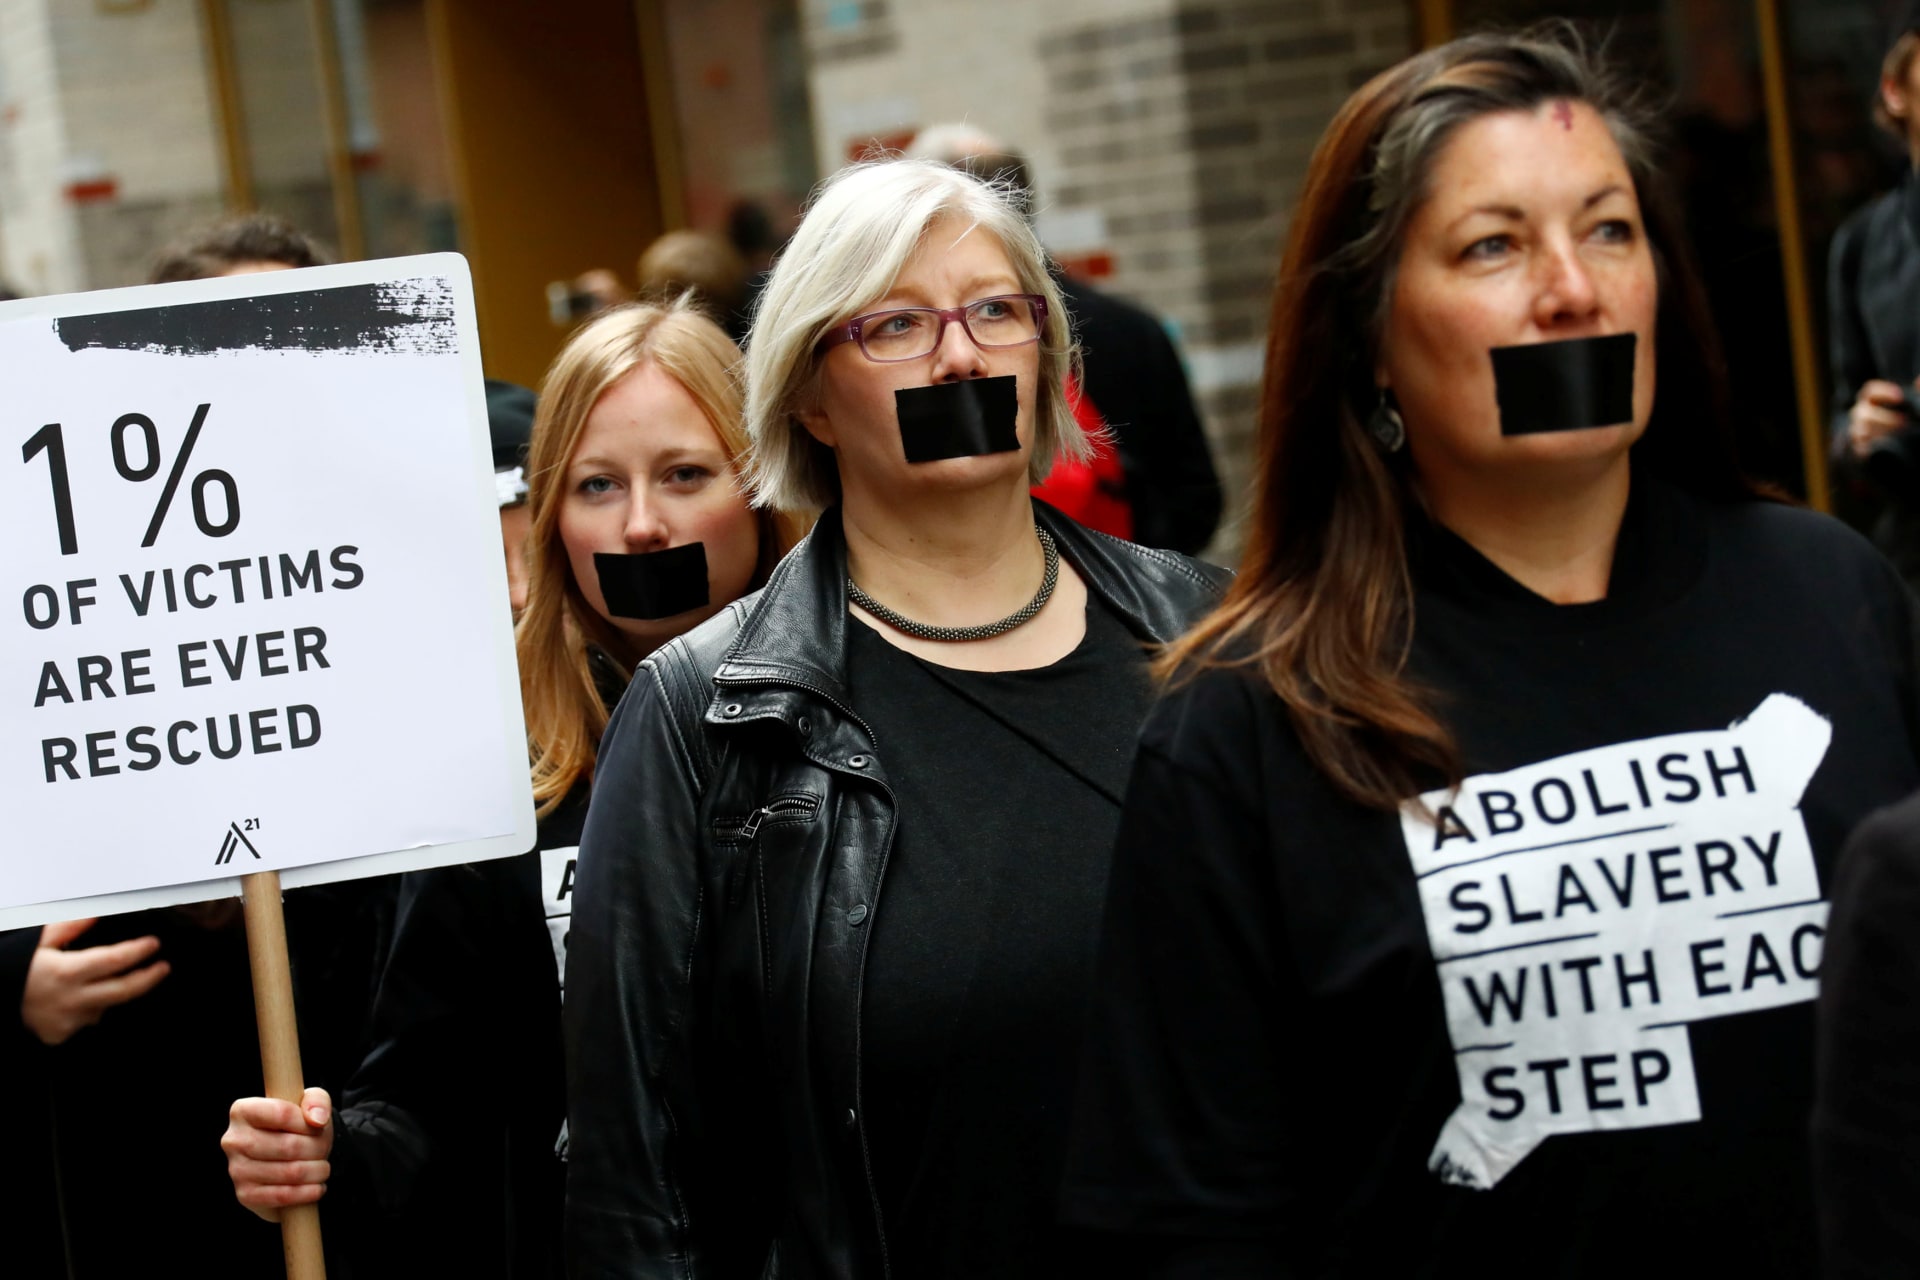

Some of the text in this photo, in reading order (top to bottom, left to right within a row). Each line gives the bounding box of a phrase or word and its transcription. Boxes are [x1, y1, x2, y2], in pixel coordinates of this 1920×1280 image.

[21, 403, 242, 556] 1%
[22, 545, 365, 630] OF VICTIMS
[33, 626, 331, 708] ARE EVER
[41, 703, 322, 783] RESCUED
[1432, 746, 1757, 851] ABOLISH
[1448, 831, 1783, 934] SLAVERY
[1463, 923, 1826, 1028] WITH EAC
[1482, 1049, 1672, 1123] STEP
